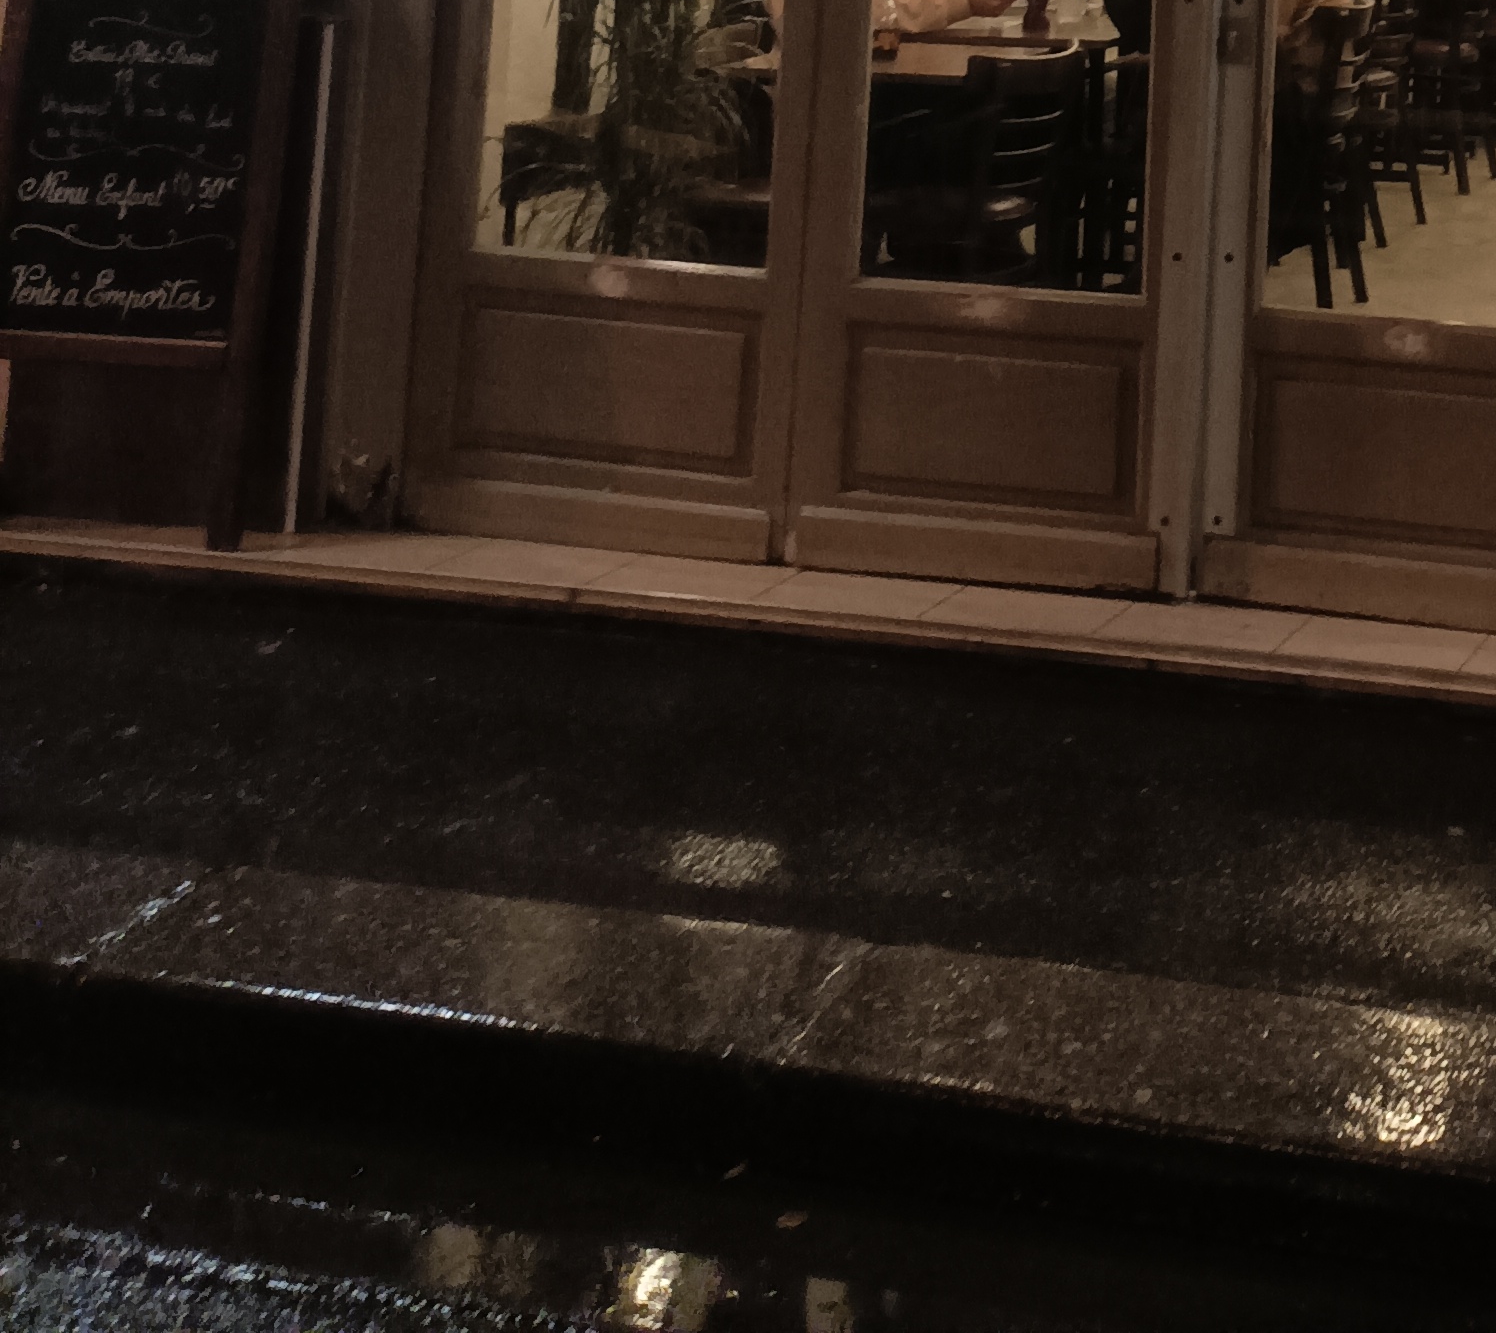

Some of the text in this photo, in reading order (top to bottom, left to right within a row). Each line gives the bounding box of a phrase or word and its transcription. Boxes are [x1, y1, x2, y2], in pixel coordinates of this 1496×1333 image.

[17, 170, 90, 206] Menu
[95, 172, 167, 220] Enfant
[9, 263, 216, 321] Vente à Emporter
